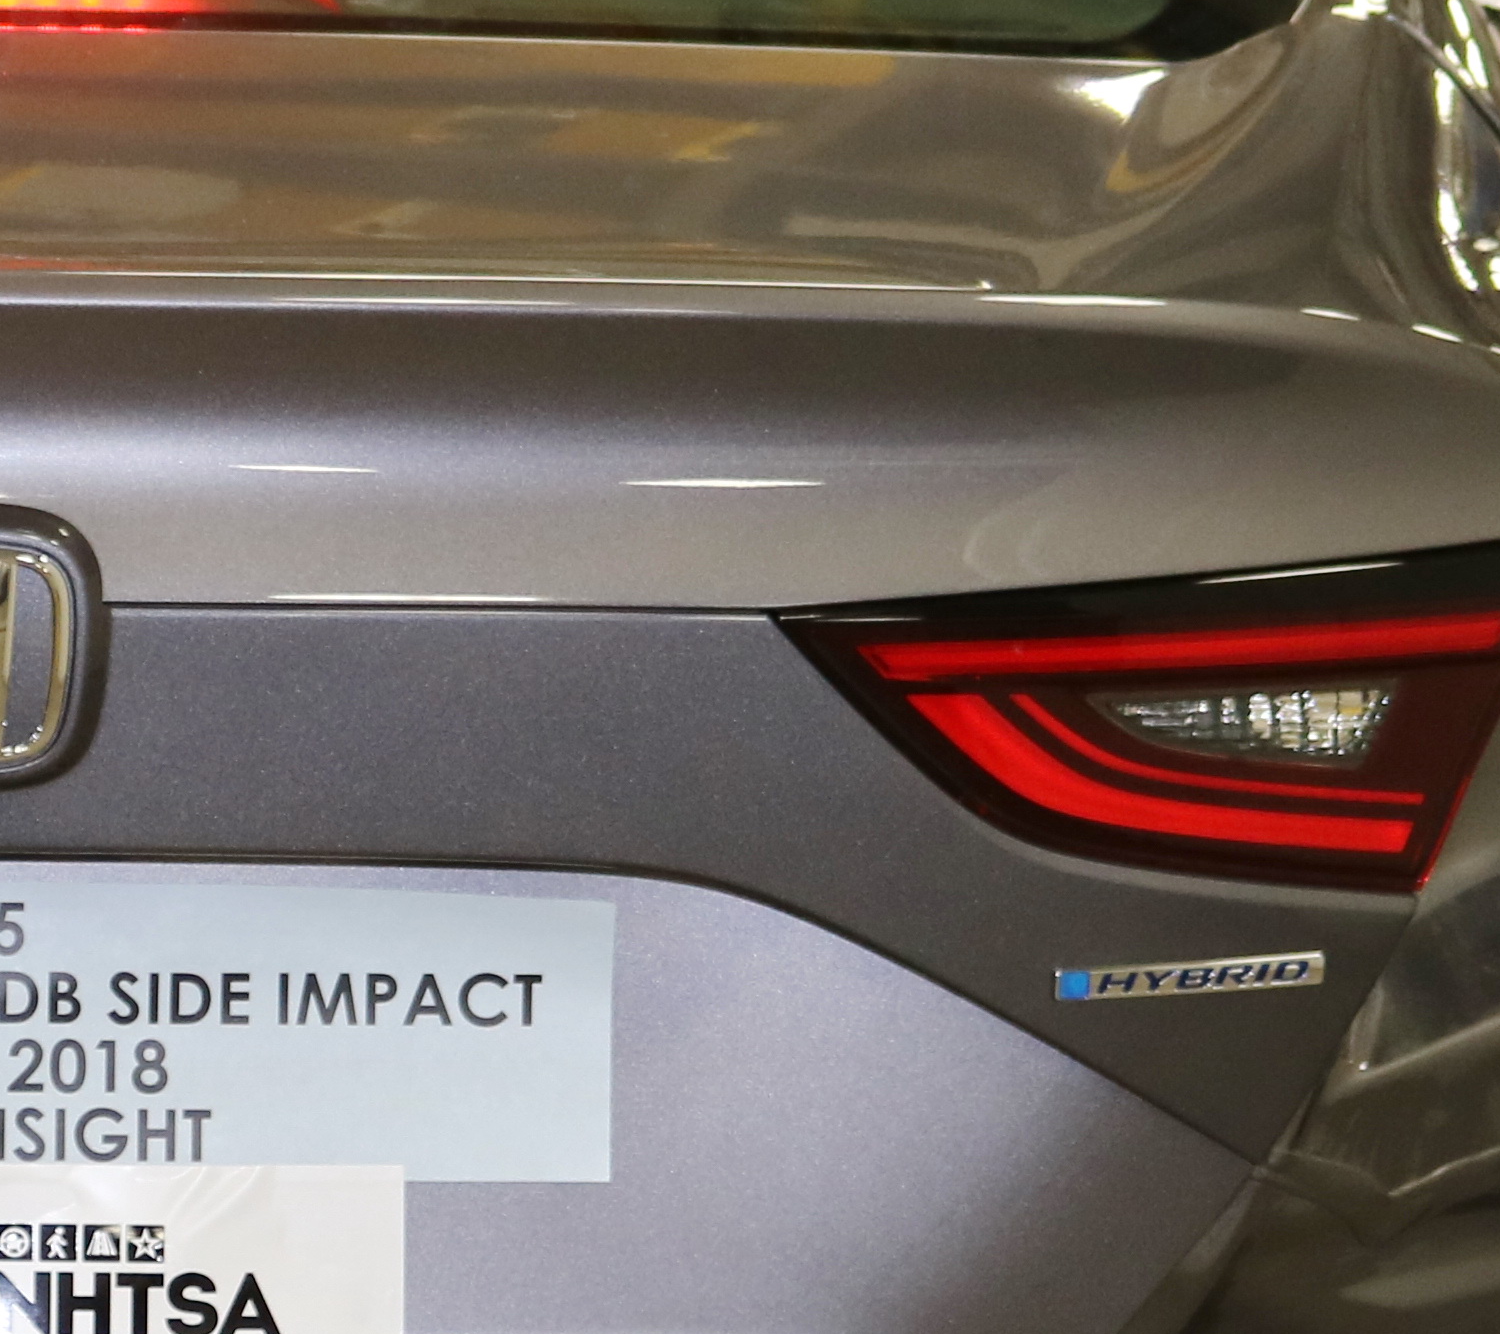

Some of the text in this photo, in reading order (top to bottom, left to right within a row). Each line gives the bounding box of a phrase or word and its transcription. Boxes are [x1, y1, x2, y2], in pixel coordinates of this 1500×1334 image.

[106, 971, 252, 1026] SIDE
[277, 972, 545, 1028] IMPACT
[1097, 961, 1309, 994] HYBRID
[6, 1037, 170, 1095] 2018
